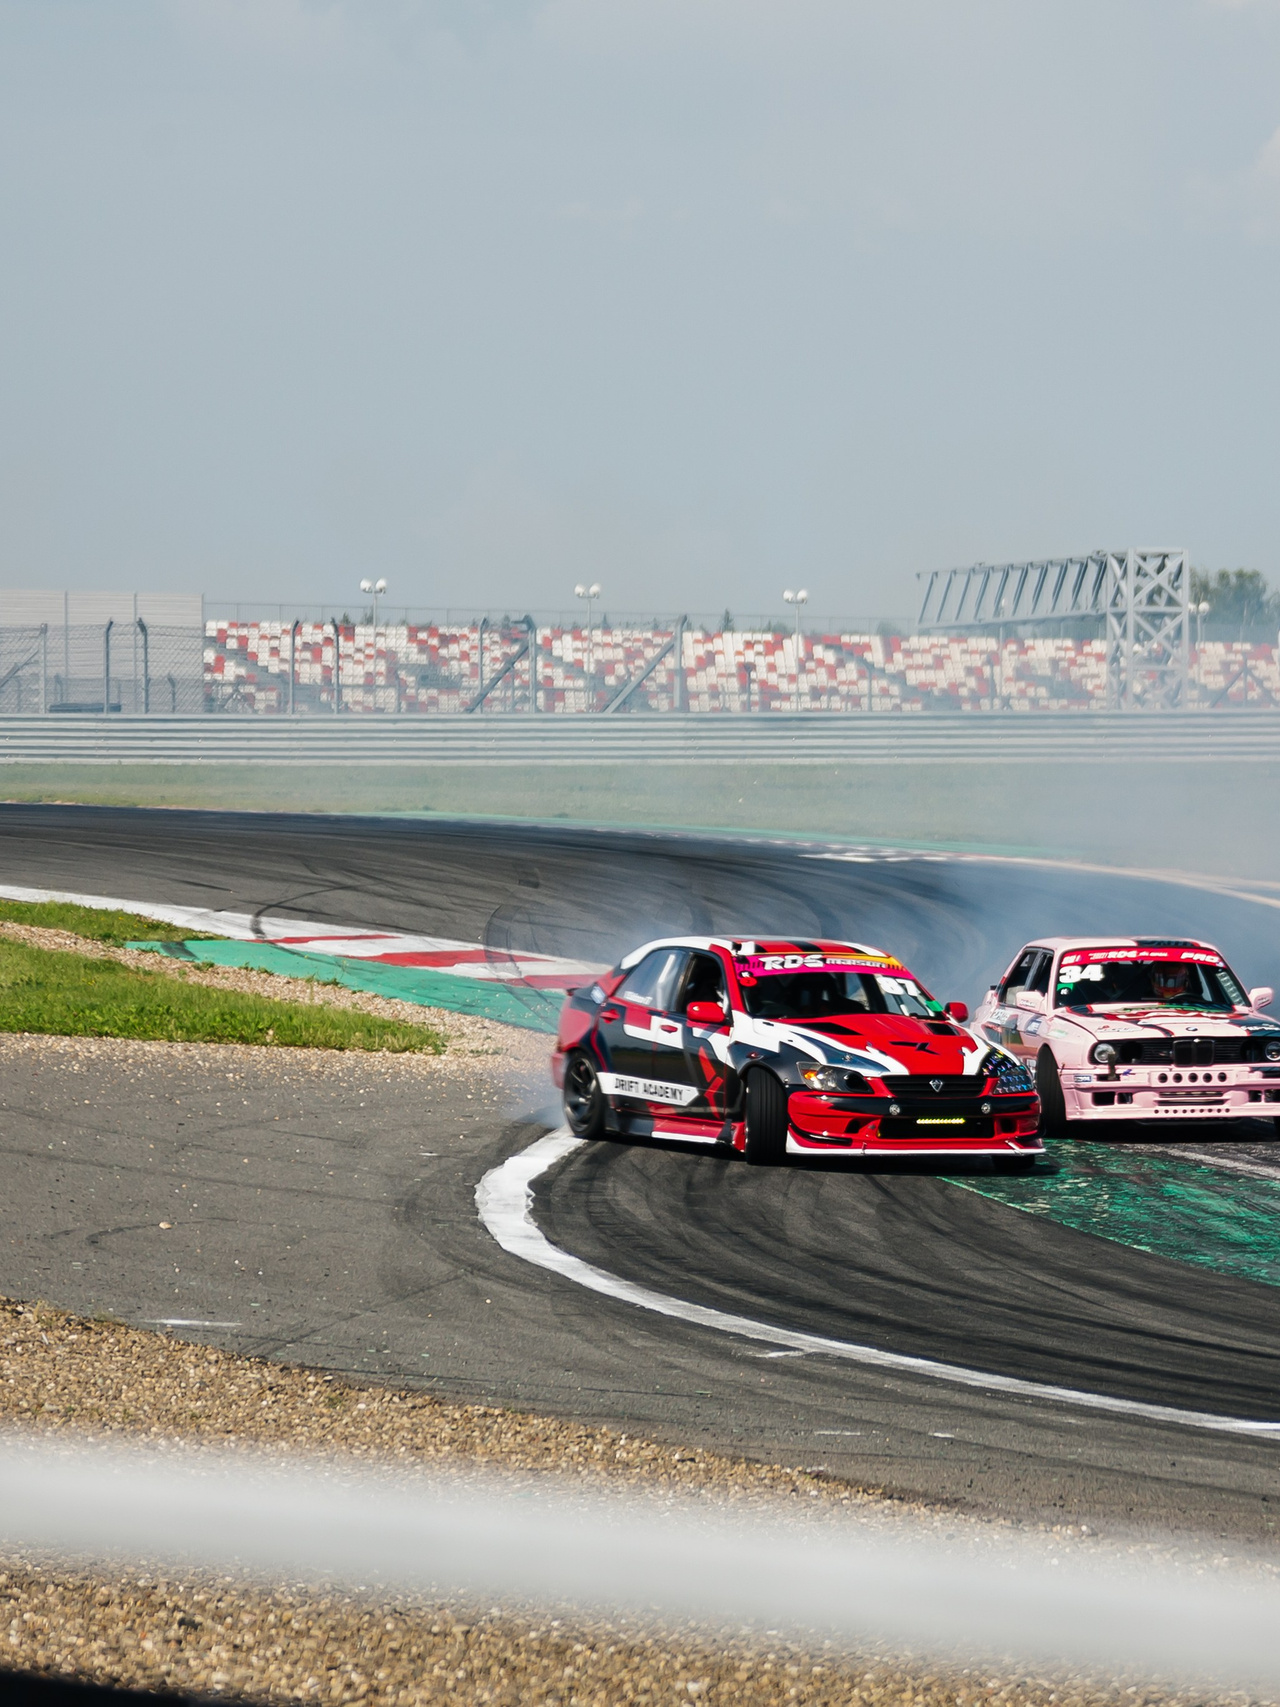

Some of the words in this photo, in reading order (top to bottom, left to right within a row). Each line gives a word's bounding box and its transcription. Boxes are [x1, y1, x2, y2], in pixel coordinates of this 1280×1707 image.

[758, 954, 824, 971] RDS
[1059, 965, 1104, 983] 34
[614, 1078, 639, 1093] DRIFT
[643, 1083, 684, 1101] ACADEMY
